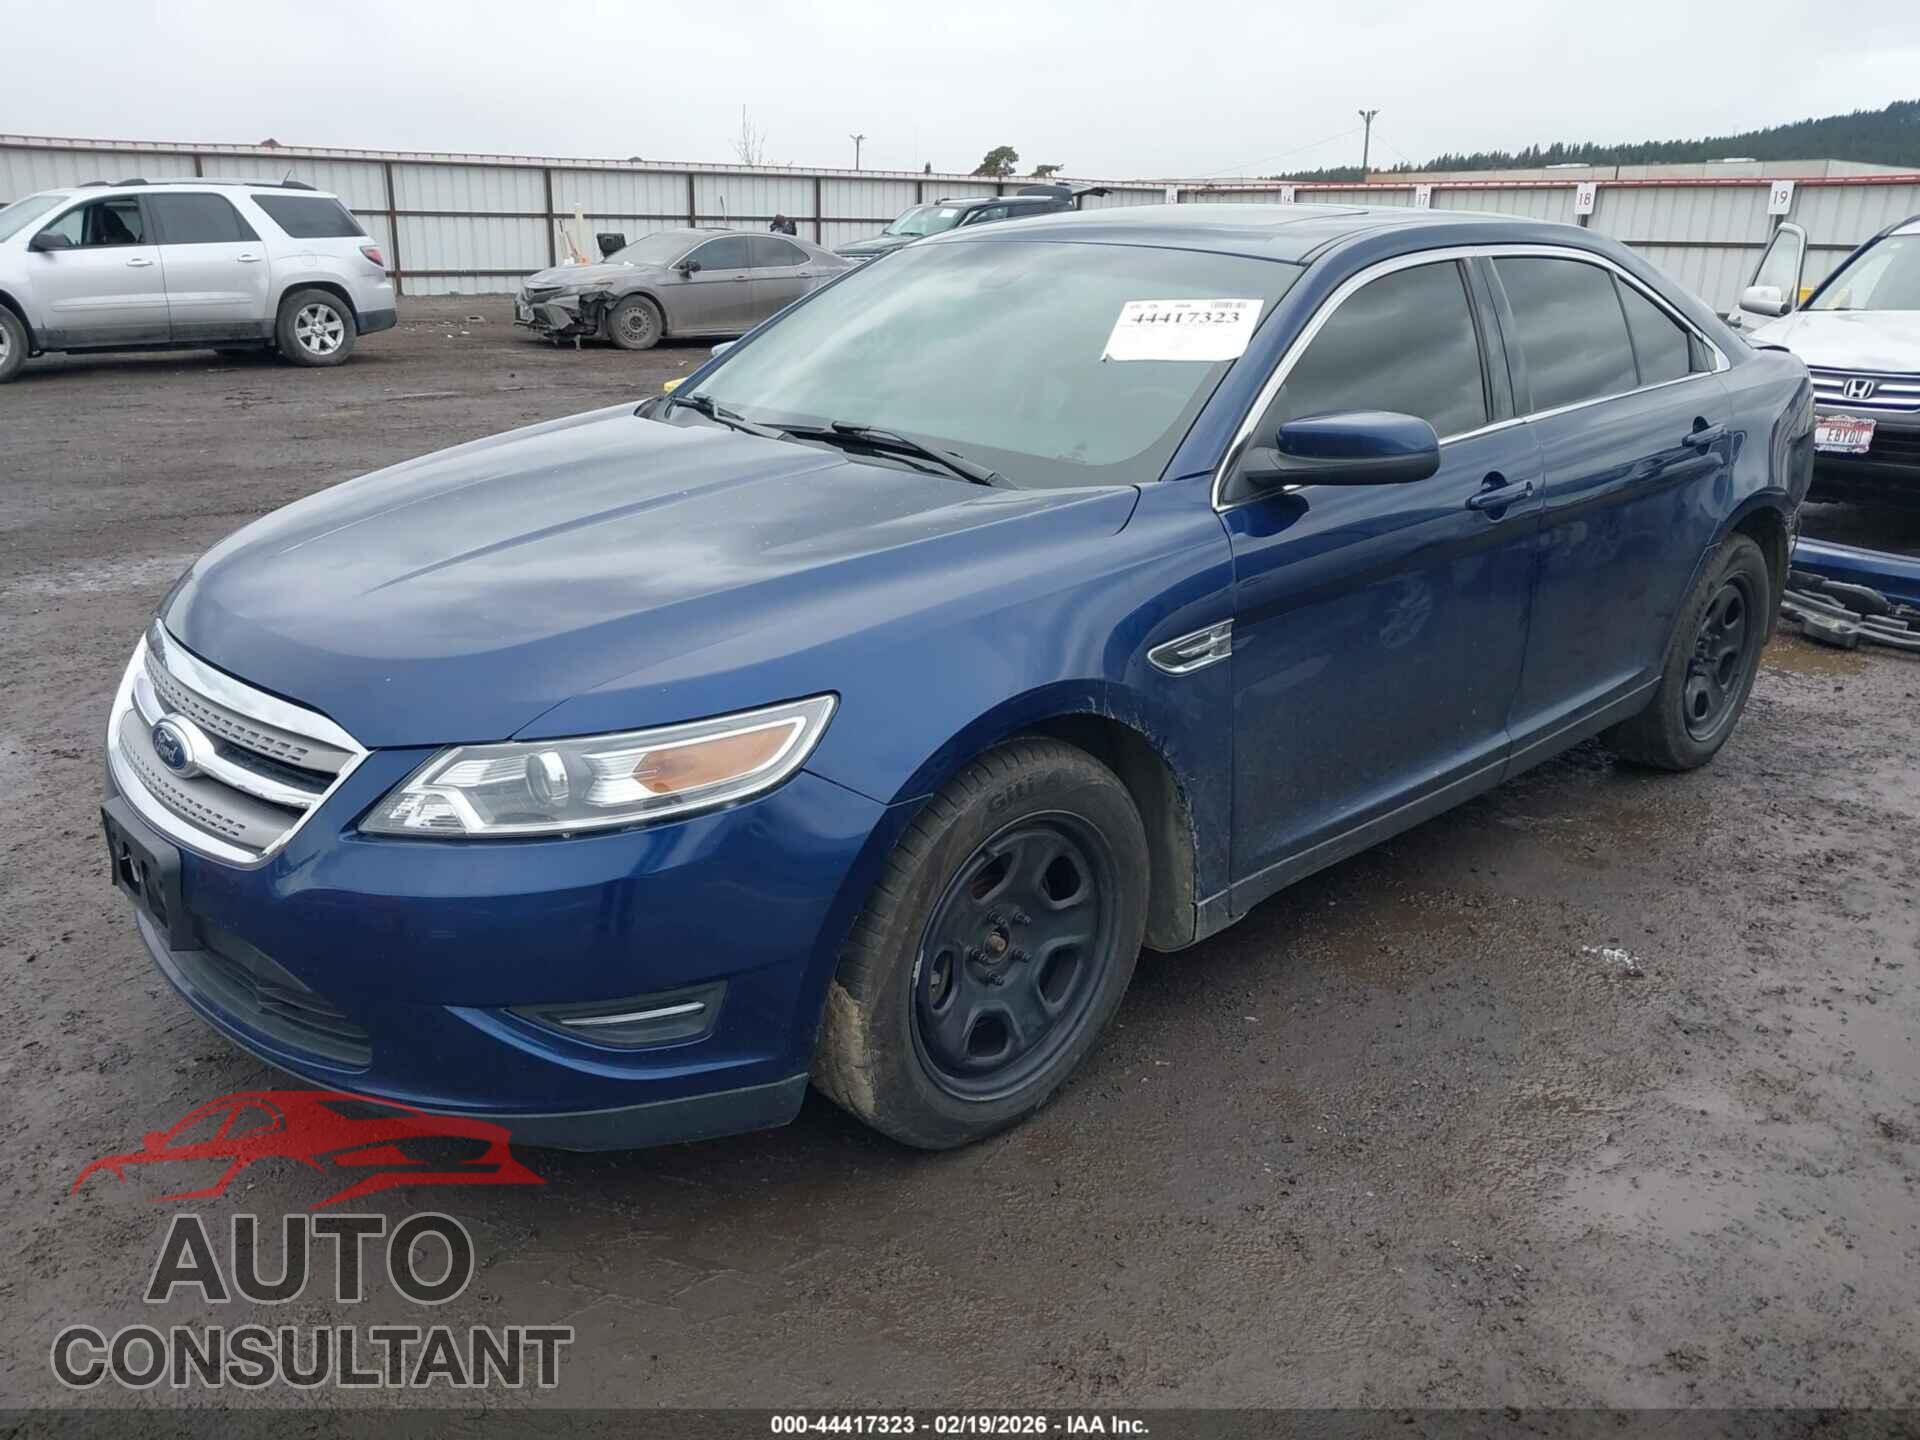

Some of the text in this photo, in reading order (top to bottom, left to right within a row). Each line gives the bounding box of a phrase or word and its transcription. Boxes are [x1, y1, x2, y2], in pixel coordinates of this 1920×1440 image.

[1578, 192, 1591, 206] 18
[1774, 190, 1788, 204] 19
[1130, 311, 1240, 324] 44417323
